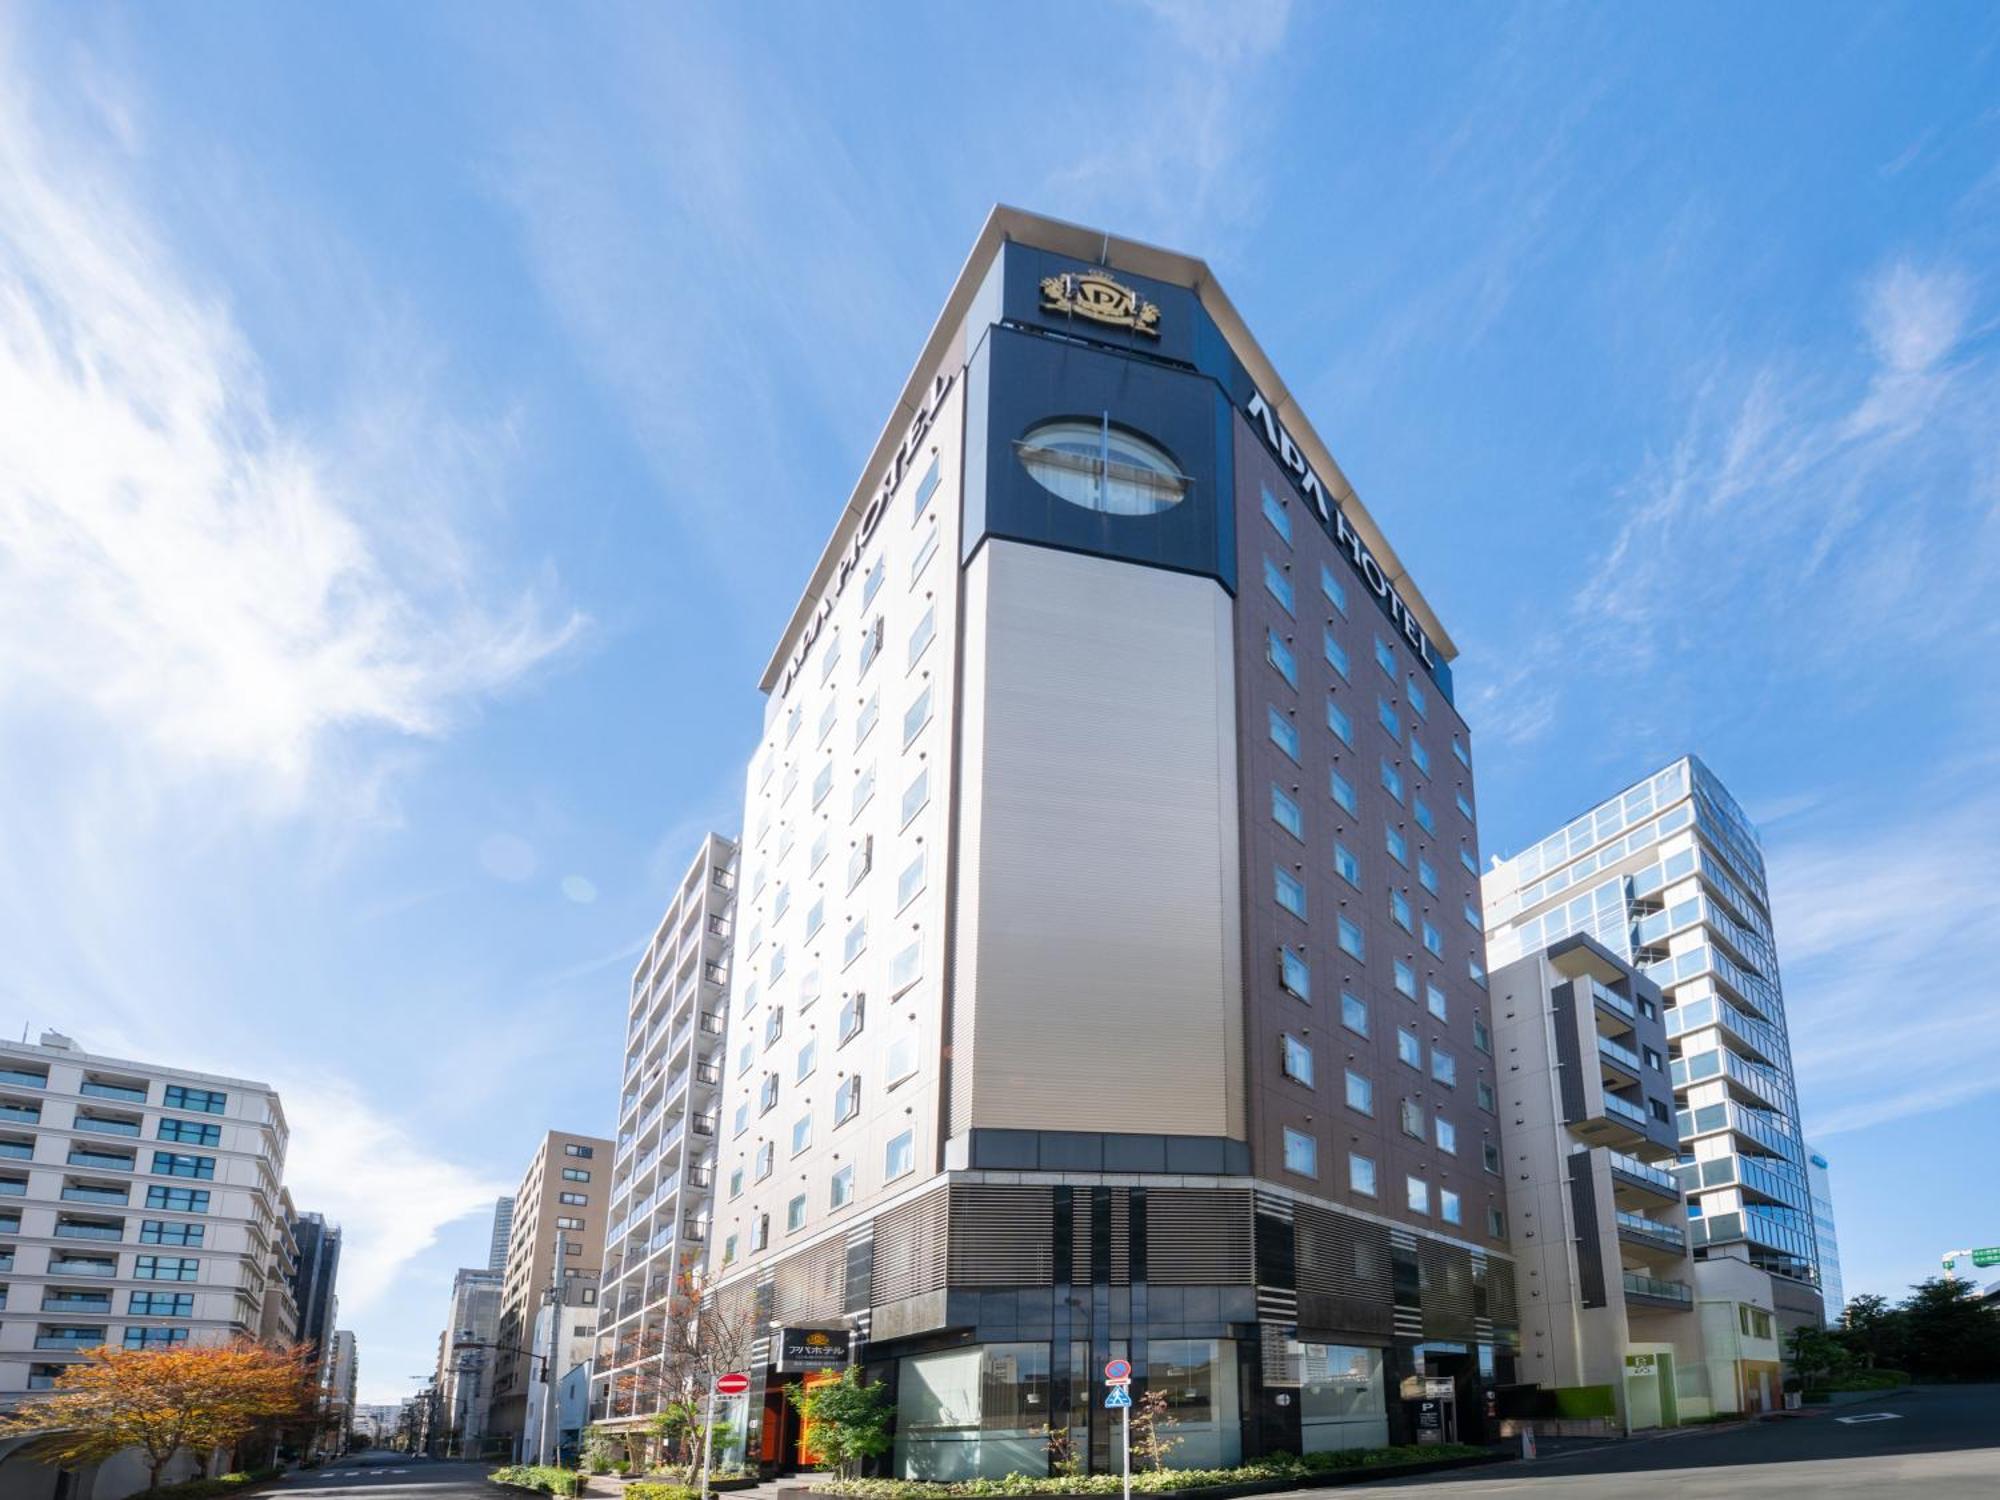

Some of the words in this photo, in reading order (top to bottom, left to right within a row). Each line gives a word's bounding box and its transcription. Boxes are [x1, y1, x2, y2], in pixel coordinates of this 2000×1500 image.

[836, 375, 954, 598] HOTEL
[1248, 391, 1329, 522] APA
[1335, 508, 1434, 669] HOTEL
[788, 1346, 845, 1355] アパホテル
[1422, 1403, 1434, 1411] P
